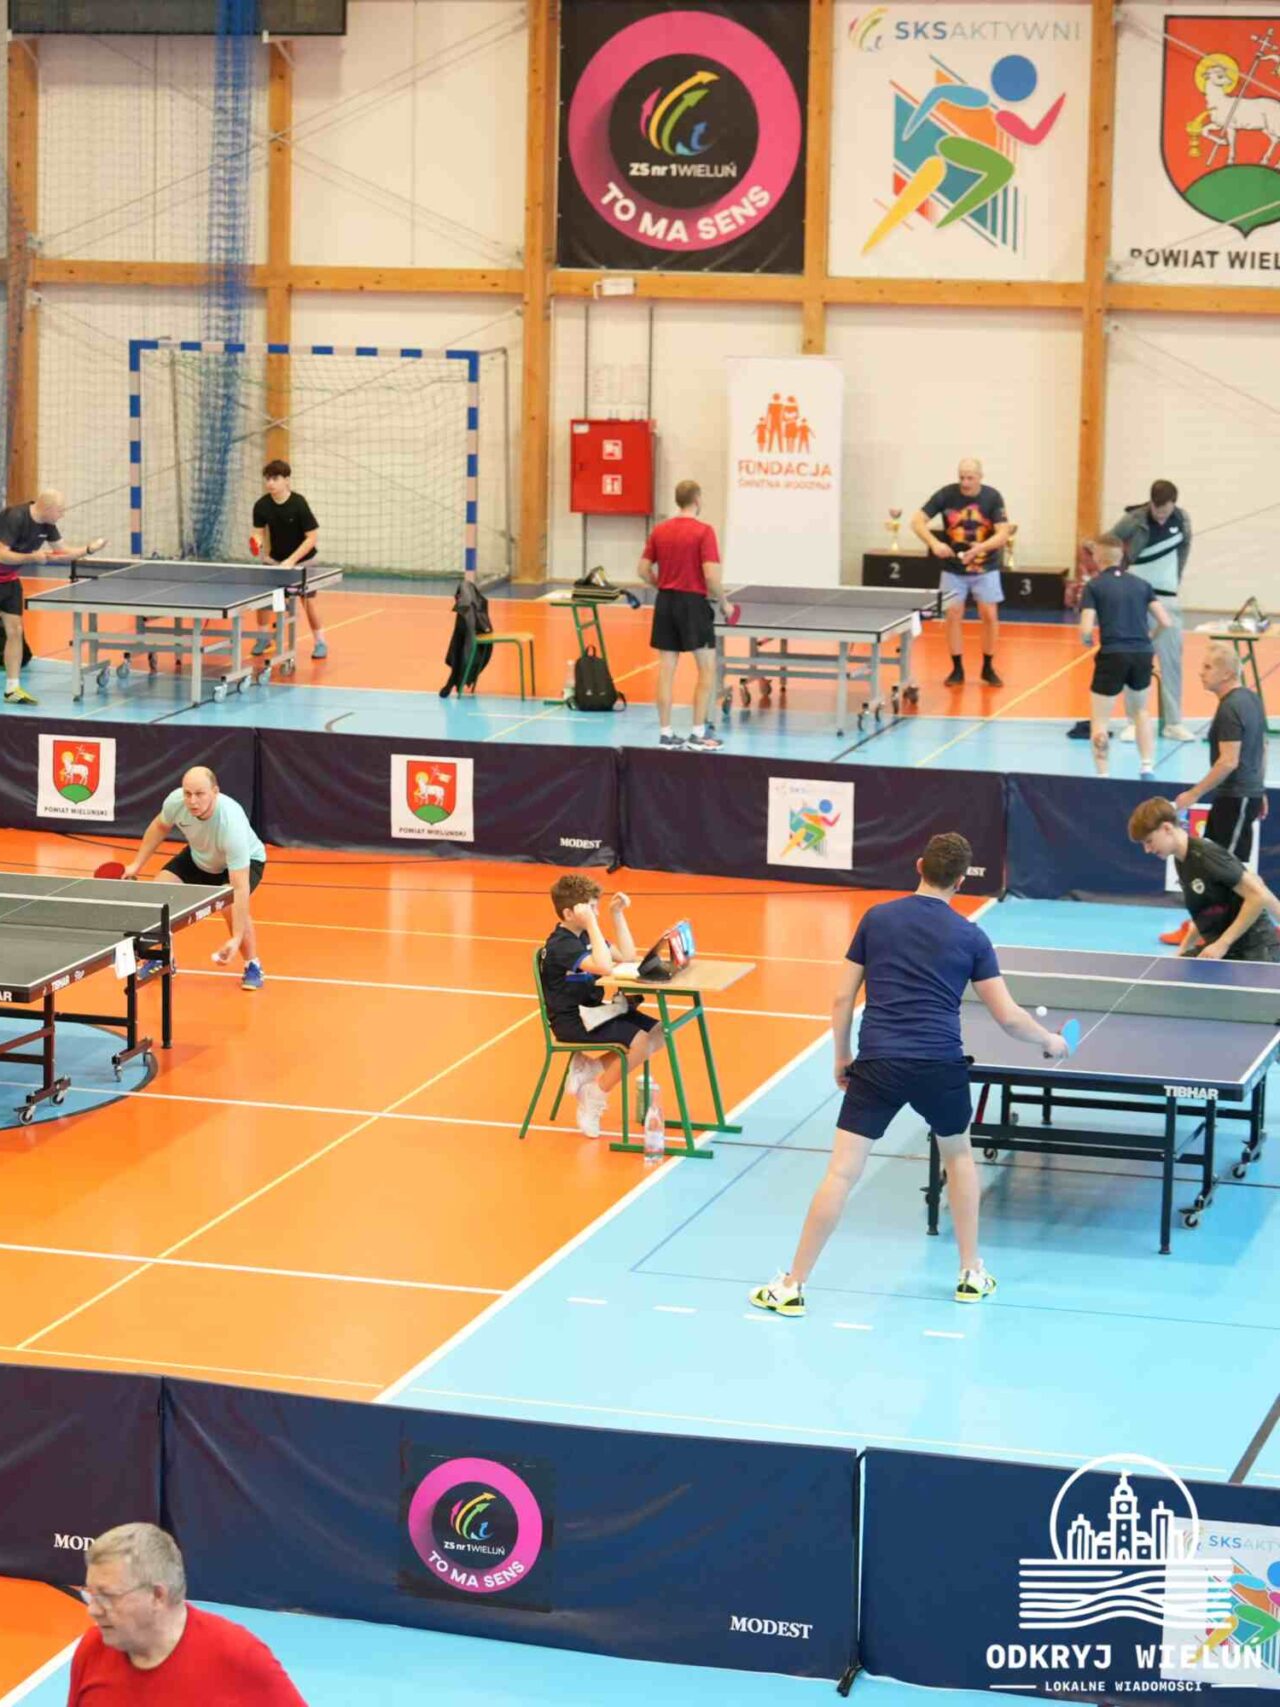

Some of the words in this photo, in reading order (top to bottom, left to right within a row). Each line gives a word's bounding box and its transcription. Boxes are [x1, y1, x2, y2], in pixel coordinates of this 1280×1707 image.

[600, 181, 637, 222] TO
[638, 211, 689, 243] MA
[696, 185, 771, 240] SENS
[1130, 248, 1220, 268] POWIAT
[737, 460, 833, 476] FUNDACJA
[888, 562, 901, 579] 2
[1020, 579, 1032, 595] 3
[559, 837, 603, 849] MODEST
[966, 866, 987, 877] EST
[1163, 1084, 1219, 1100] TIBHAR
[53, 1533, 96, 1551] MOD
[428, 1550, 449, 1573] TO
[450, 1568, 479, 1588] MA
[483, 1560, 525, 1588] SENS
[729, 1615, 814, 1639] MODEST
